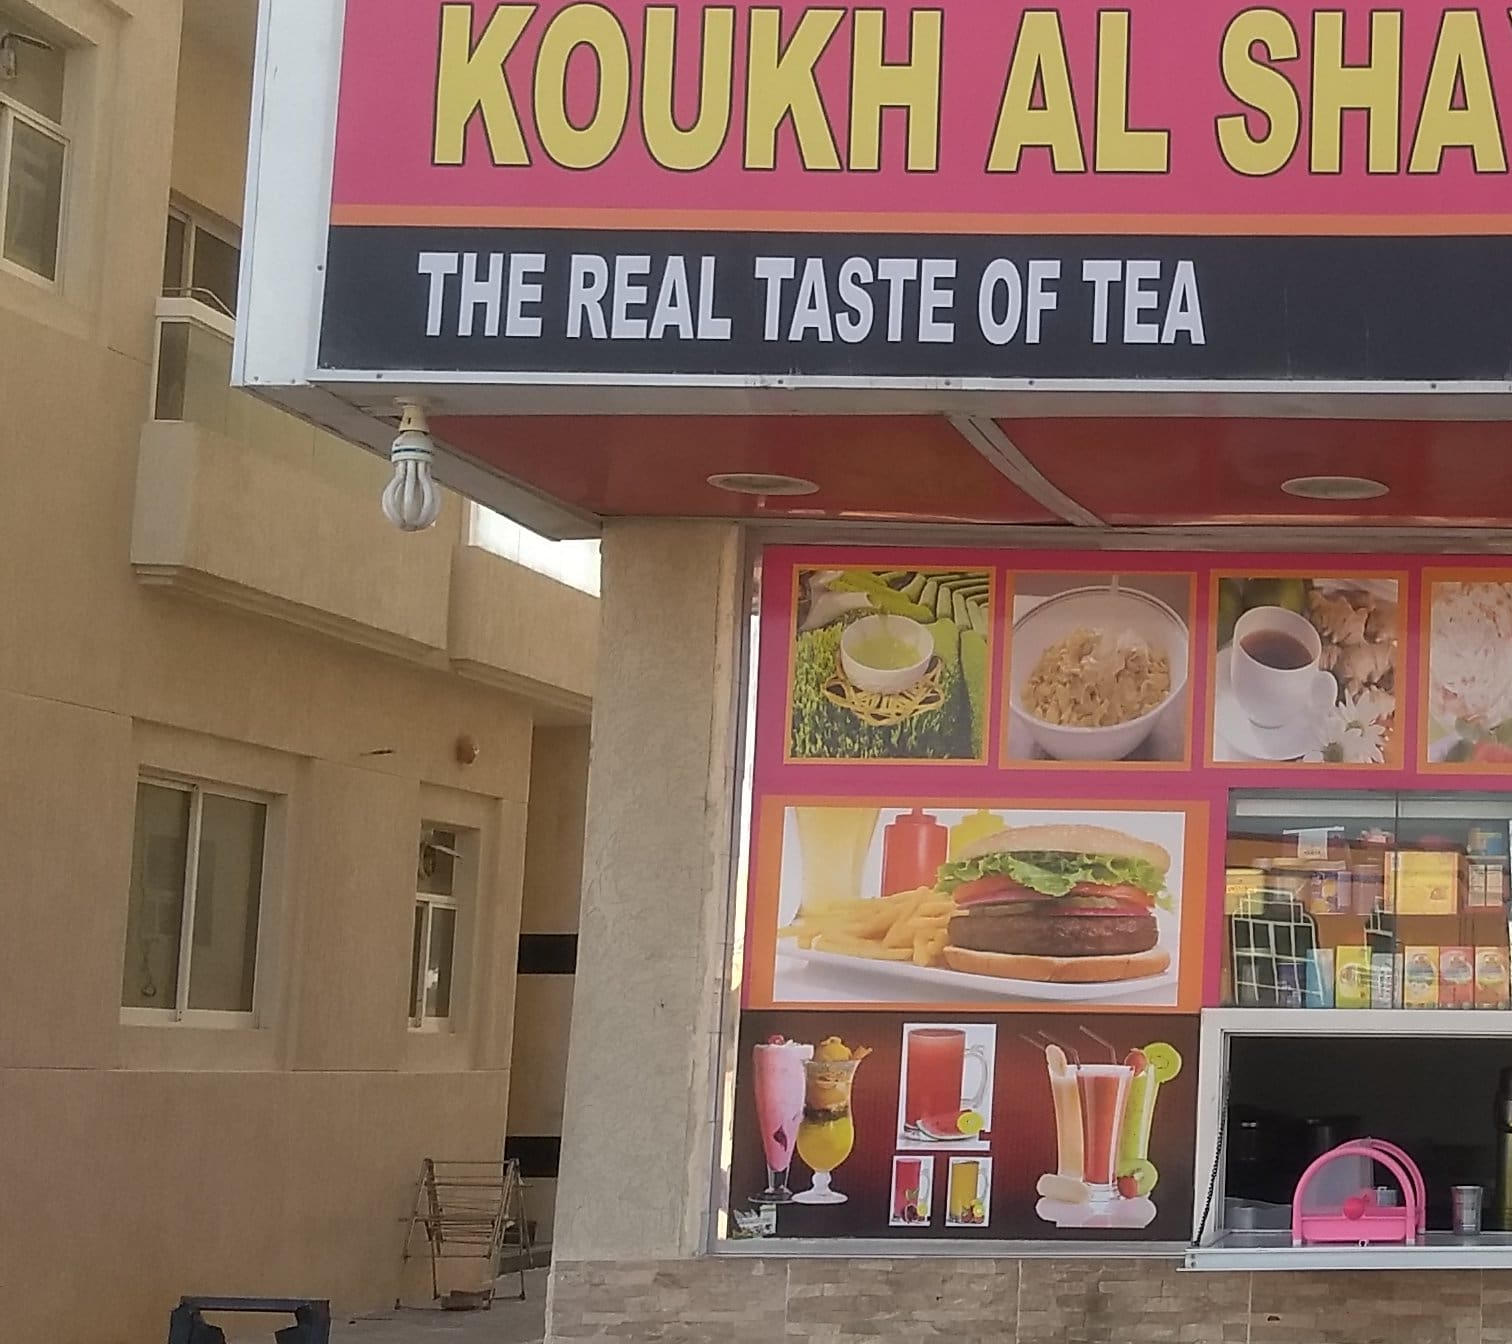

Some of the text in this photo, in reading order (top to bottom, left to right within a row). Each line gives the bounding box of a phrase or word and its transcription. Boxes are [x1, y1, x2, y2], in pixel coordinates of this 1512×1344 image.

[430, 1, 945, 174] KOUKH
[985, 8, 1171, 175] AL
[417, 251, 1207, 347] THE REAL TASTE OF TEA
